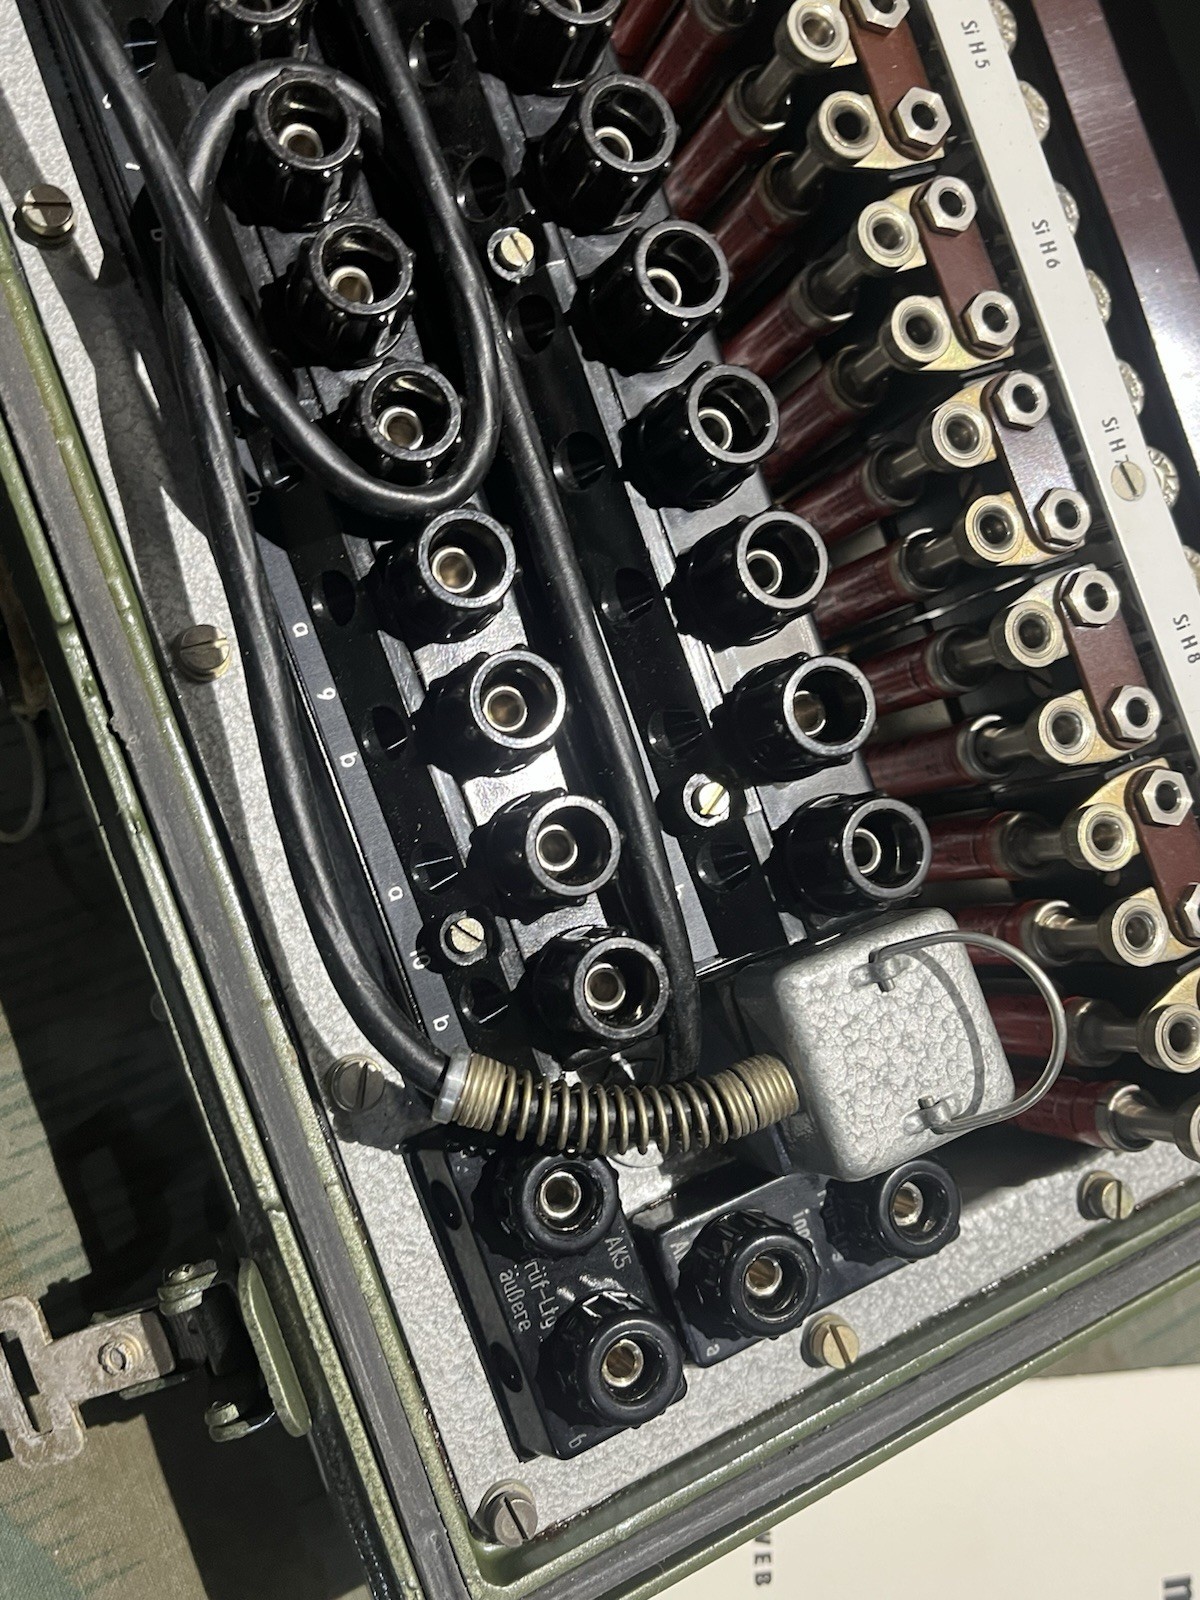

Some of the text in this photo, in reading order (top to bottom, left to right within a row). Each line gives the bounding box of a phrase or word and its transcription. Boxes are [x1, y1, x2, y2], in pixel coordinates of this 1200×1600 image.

[961, 20, 991, 69] Si H 5
[1032, 219, 1061, 269] Si H 6
[1101, 416, 1120, 433] Si
[1109, 438, 1126, 452] H
[1172, 613, 1200, 664] Si H 8
[292, 622, 358, 768] a 9 b
[388, 885, 404, 902] a
[432, 1014, 450, 1031] b
[604, 1236, 632, 1270] AK5
[499, 1264, 531, 1332] äußere
[524, 1259, 560, 1330] rüf-Ltg
[706, 1343, 720, 1357] a
[754, 1531, 772, 1586] VEB
